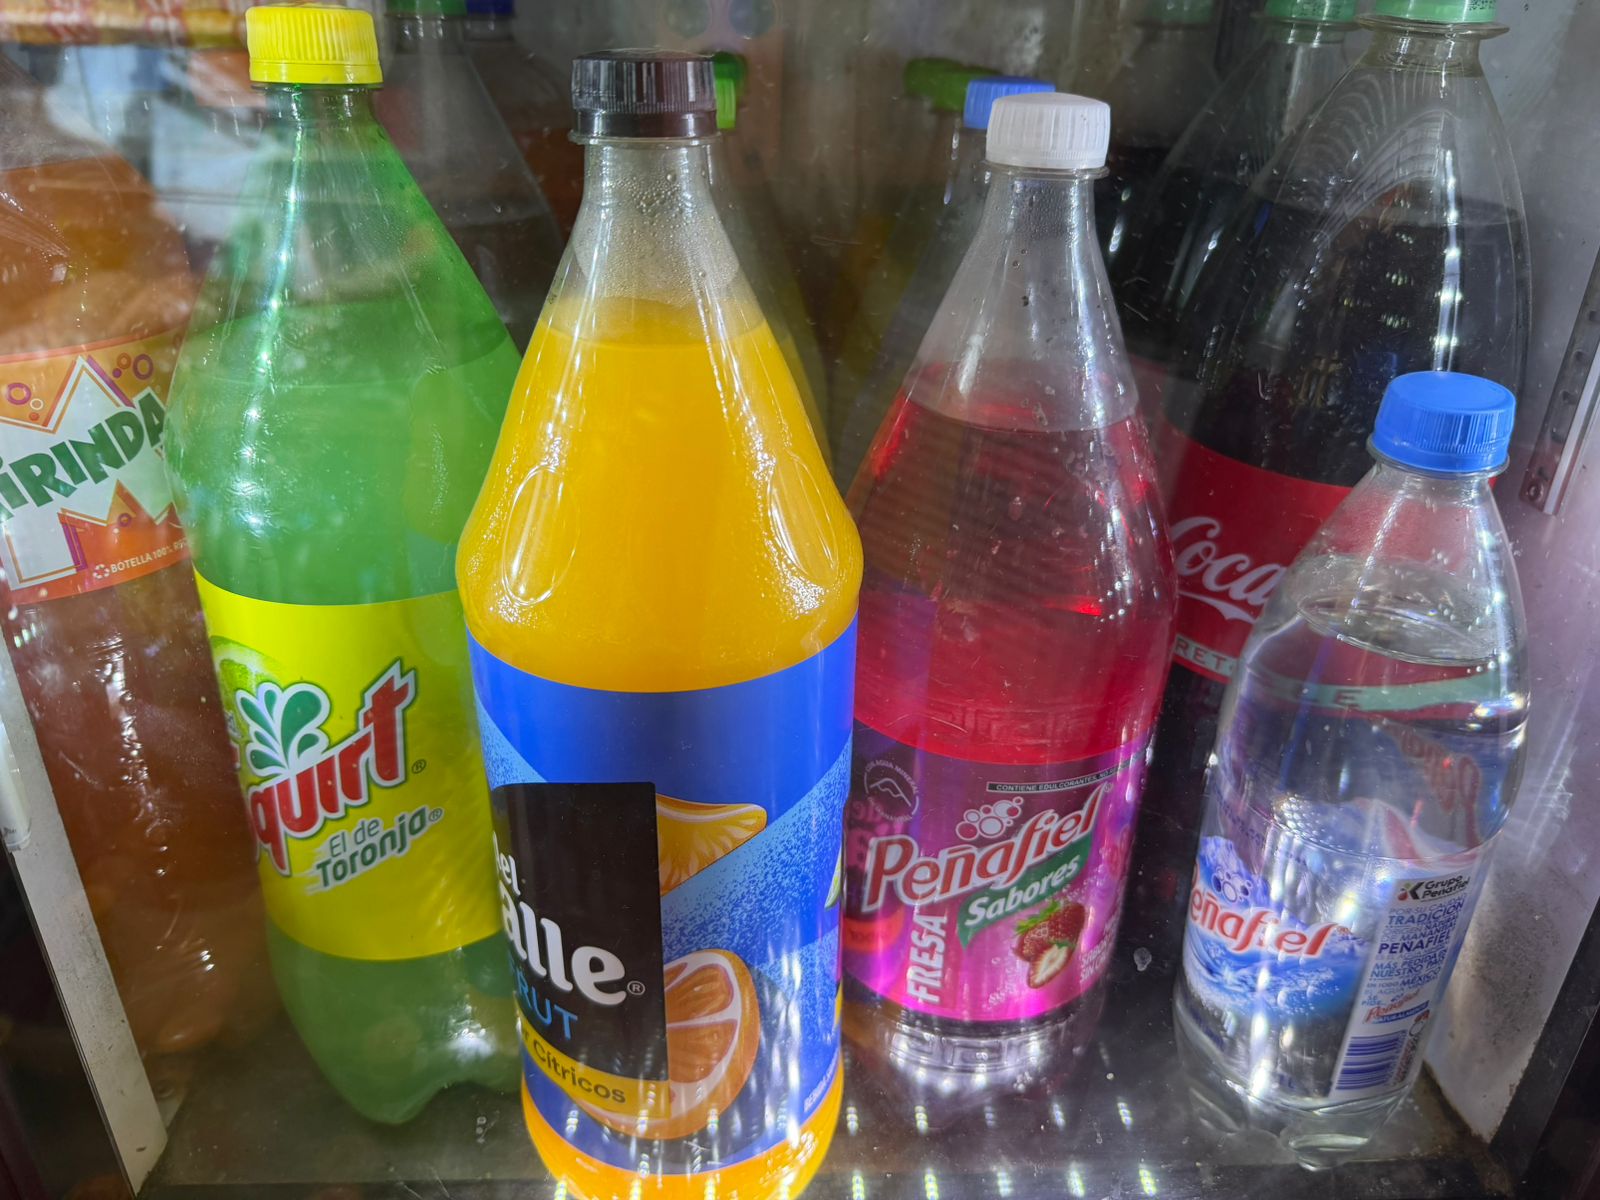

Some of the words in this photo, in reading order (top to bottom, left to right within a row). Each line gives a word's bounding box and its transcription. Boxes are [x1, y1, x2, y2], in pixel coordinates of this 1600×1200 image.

[110, 551, 152, 573] BOTELLA
[246, 660, 415, 876] quirt
[996, 783, 1038, 792] CONTIENE
[316, 806, 428, 889] Toronja
[329, 832, 347, 858] El
[353, 818, 382, 846] de
[861, 782, 1106, 912] Peñafiel
[965, 854, 1082, 927] Sabores
[1425, 875, 1463, 890] Grupo
[499, 879, 627, 1006] alle
[907, 908, 949, 1004] FRESA
[533, 1037, 627, 1104] Cítricos
